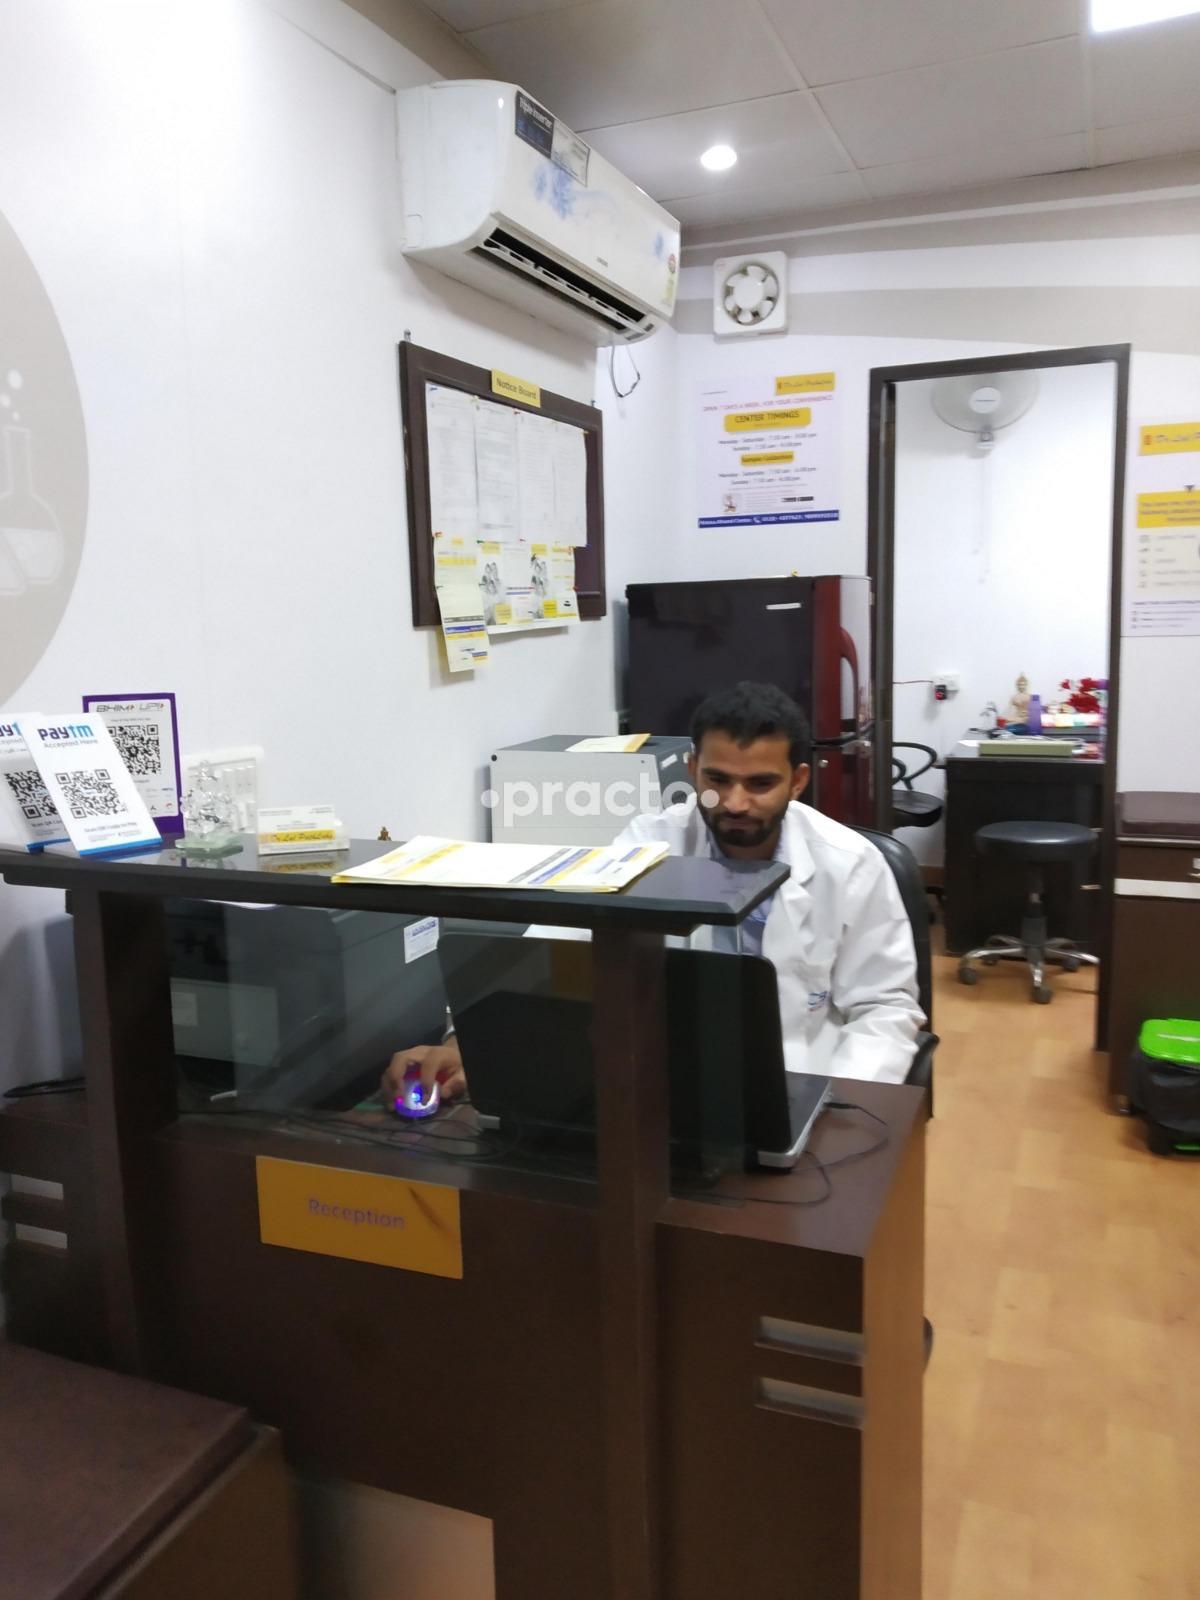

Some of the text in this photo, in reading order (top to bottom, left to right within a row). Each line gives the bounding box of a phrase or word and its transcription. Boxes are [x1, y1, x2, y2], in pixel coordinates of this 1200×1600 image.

[496, 377, 537, 400] Notice Board
[735, 409, 801, 424] CENTER TIMINGS
[308, 1197, 406, 1229] Reception
